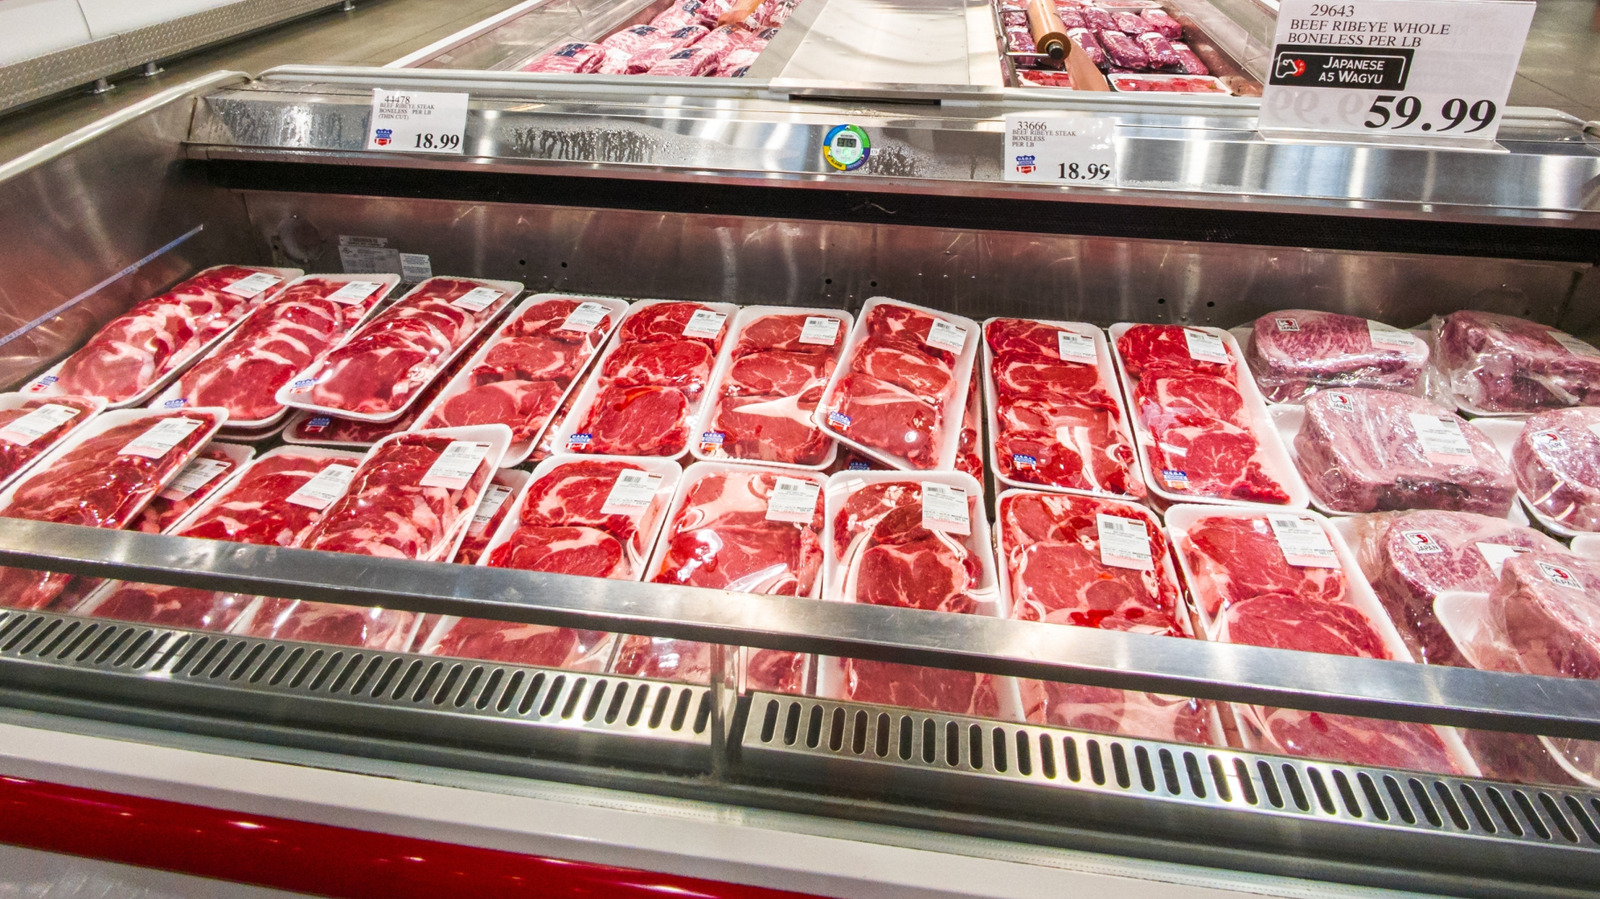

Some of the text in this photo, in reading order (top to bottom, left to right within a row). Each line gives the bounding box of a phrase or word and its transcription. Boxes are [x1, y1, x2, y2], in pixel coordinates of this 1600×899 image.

[1310, 4, 1355, 17] 29643
[1290, 19, 1451, 35] BEEF RIBEYE WHOLE
[1287, 33, 1422, 47] BONELESS PER LB
[1318, 72, 1335, 82] A5
[384, 95, 411, 104] 44478
[1364, 95, 1497, 133] 59.99
[1017, 121, 1047, 131] 33666
[414, 133, 460, 149] 18.99
[1058, 163, 1111, 180] 18.99
[1334, 402, 1353, 411] JAPAN
[1551, 577, 1582, 589] JAPAN
